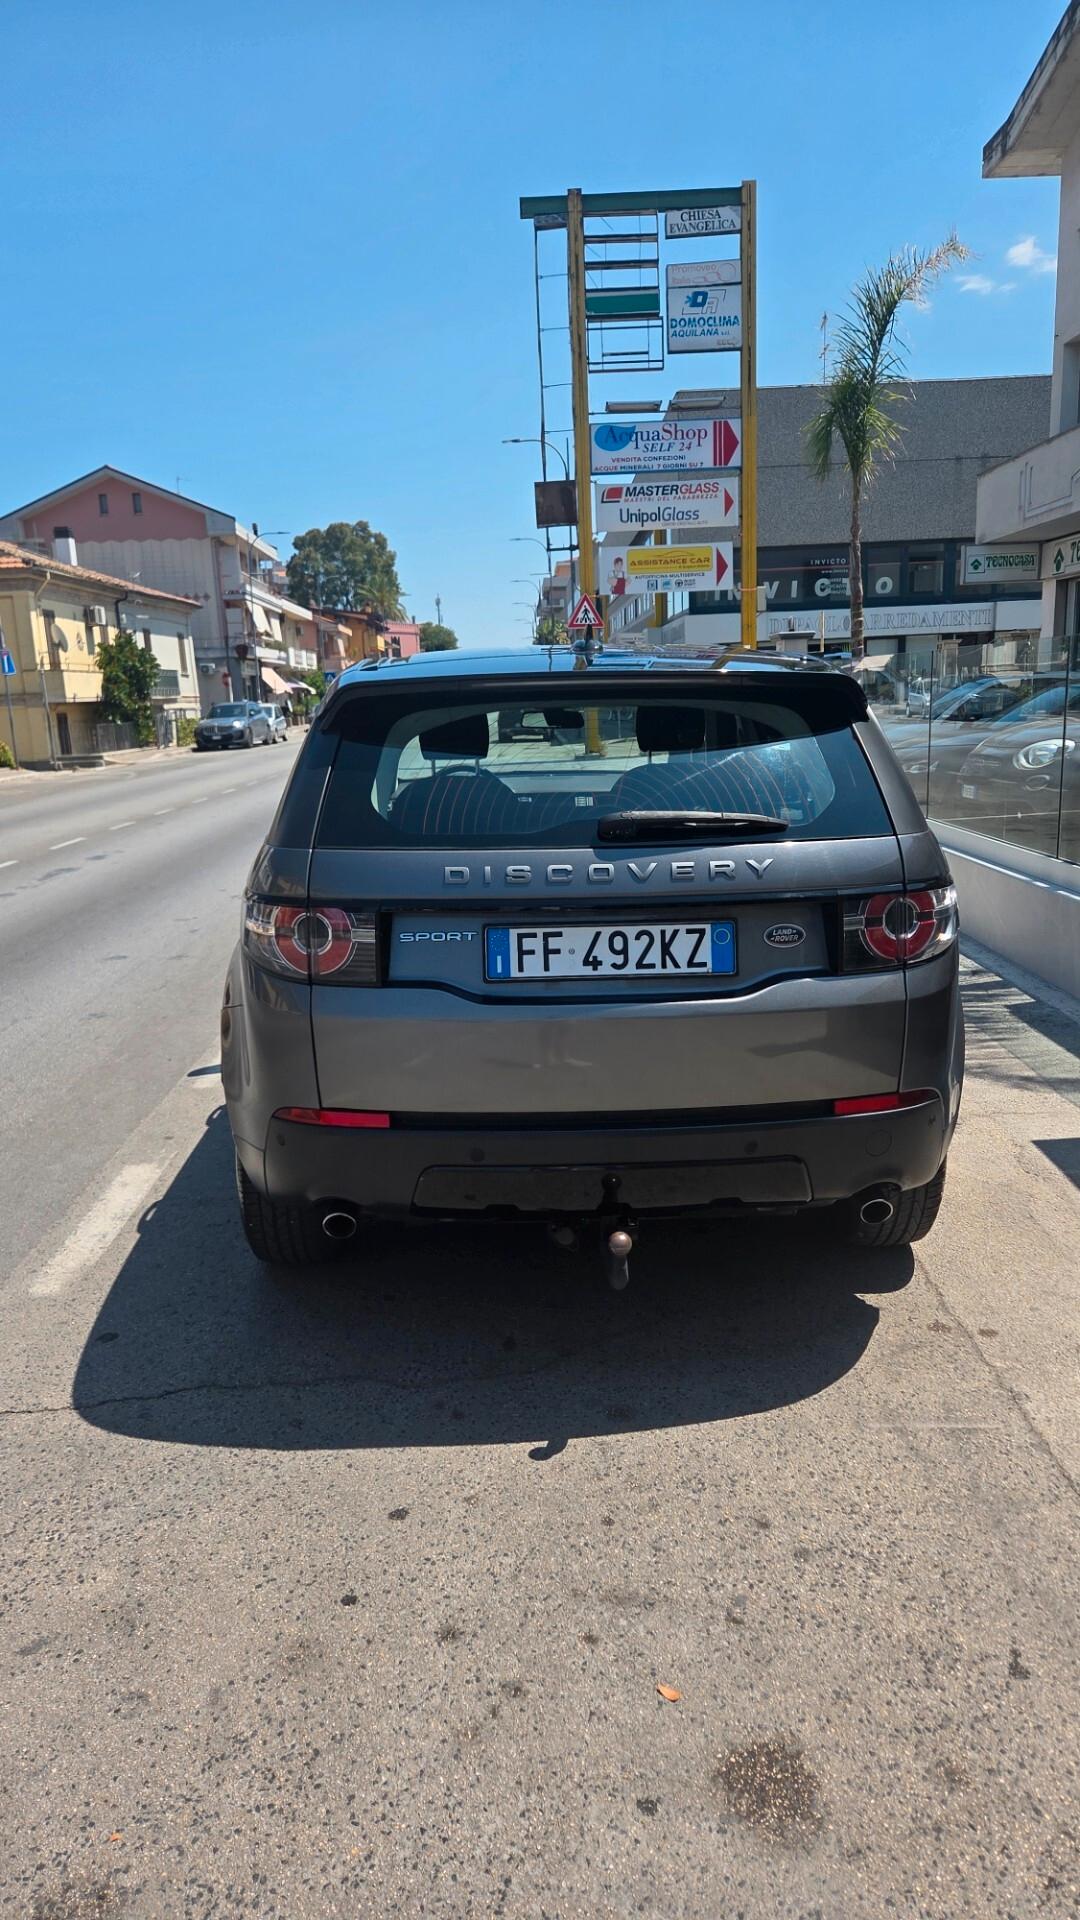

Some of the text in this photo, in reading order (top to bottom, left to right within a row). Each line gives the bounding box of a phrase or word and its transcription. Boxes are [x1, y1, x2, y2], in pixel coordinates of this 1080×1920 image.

[680, 209, 722, 222] CHIESA
[669, 219, 737, 234] EVANGELICA
[670, 315, 740, 329] DOMOCLIMA
[671, 328, 719, 338] AQUILANA
[607, 422, 708, 451] AcquaShop
[642, 441, 693, 453] SELF 24
[643, 454, 686, 463] CONFEZIONI
[662, 462, 687, 470] GIORNI
[625, 481, 720, 498] MASTERGLASS
[619, 506, 700, 528] UnipolGlass
[630, 556, 710, 566] ASSISTANCE CAR
[985, 553, 1037, 569] TECNOCASA
[444, 858, 774, 885] DISCOVERY
[400, 931, 478, 943] SPORT
[772, 928, 793, 936] LAND
[774, 934, 799, 942] ROVER
[516, 928, 708, 973] FF 492KZ
